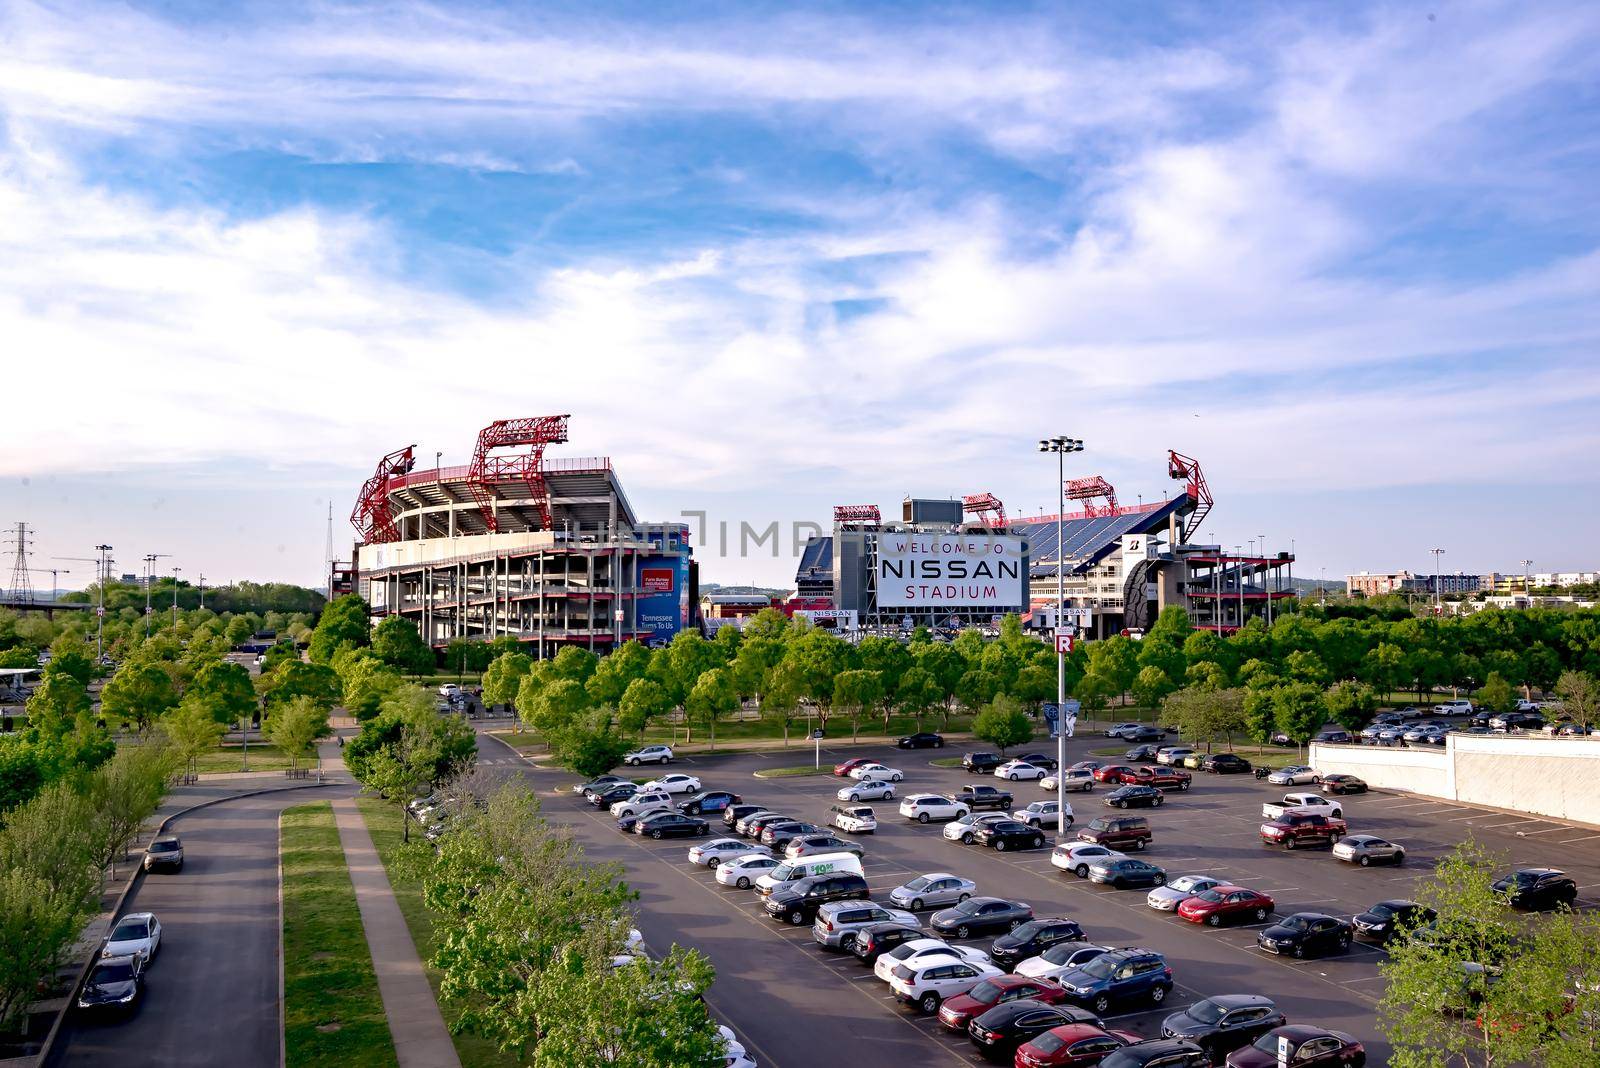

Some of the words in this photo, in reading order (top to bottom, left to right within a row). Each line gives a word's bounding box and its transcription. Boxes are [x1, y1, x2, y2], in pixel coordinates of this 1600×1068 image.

[896, 542, 975, 554] WELCOME
[984, 543, 1004, 554] TO
[882, 560, 1018, 579] NISSAN
[906, 585, 997, 599] STADIUM
[641, 614, 673, 622] Tennessee
[1059, 637, 1070, 651] R
